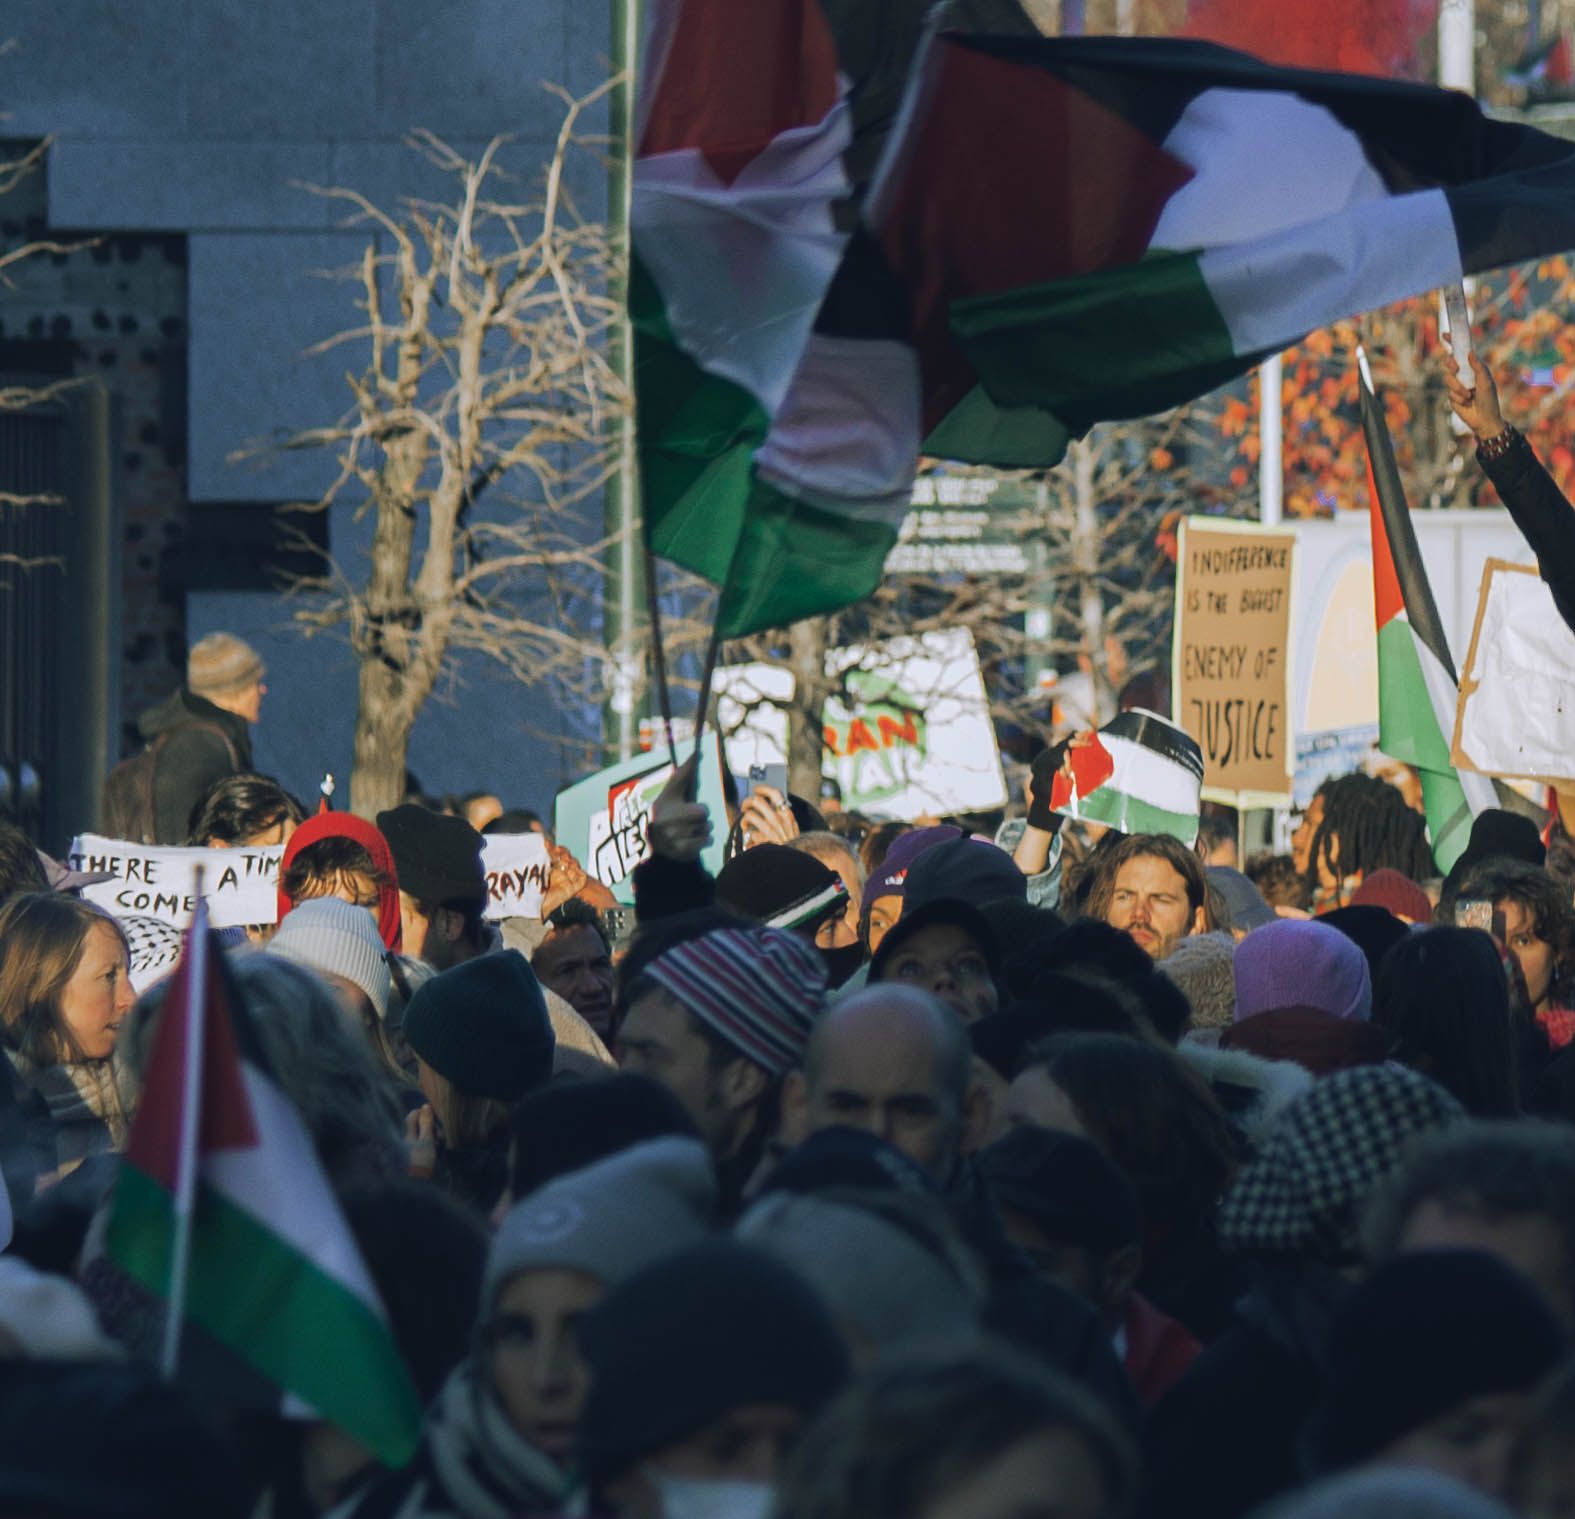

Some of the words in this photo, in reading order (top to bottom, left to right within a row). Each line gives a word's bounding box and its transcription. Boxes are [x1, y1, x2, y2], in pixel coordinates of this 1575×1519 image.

[1192, 544, 1288, 575] INDIFFERENCE
[1186, 588, 1199, 612] IS
[1184, 644, 1248, 681] ENEMY
[1254, 646, 1279, 679] OF
[1191, 699, 1280, 769] JUSTICE
[68, 853, 163, 885] THERE
[217, 866, 238, 892] A
